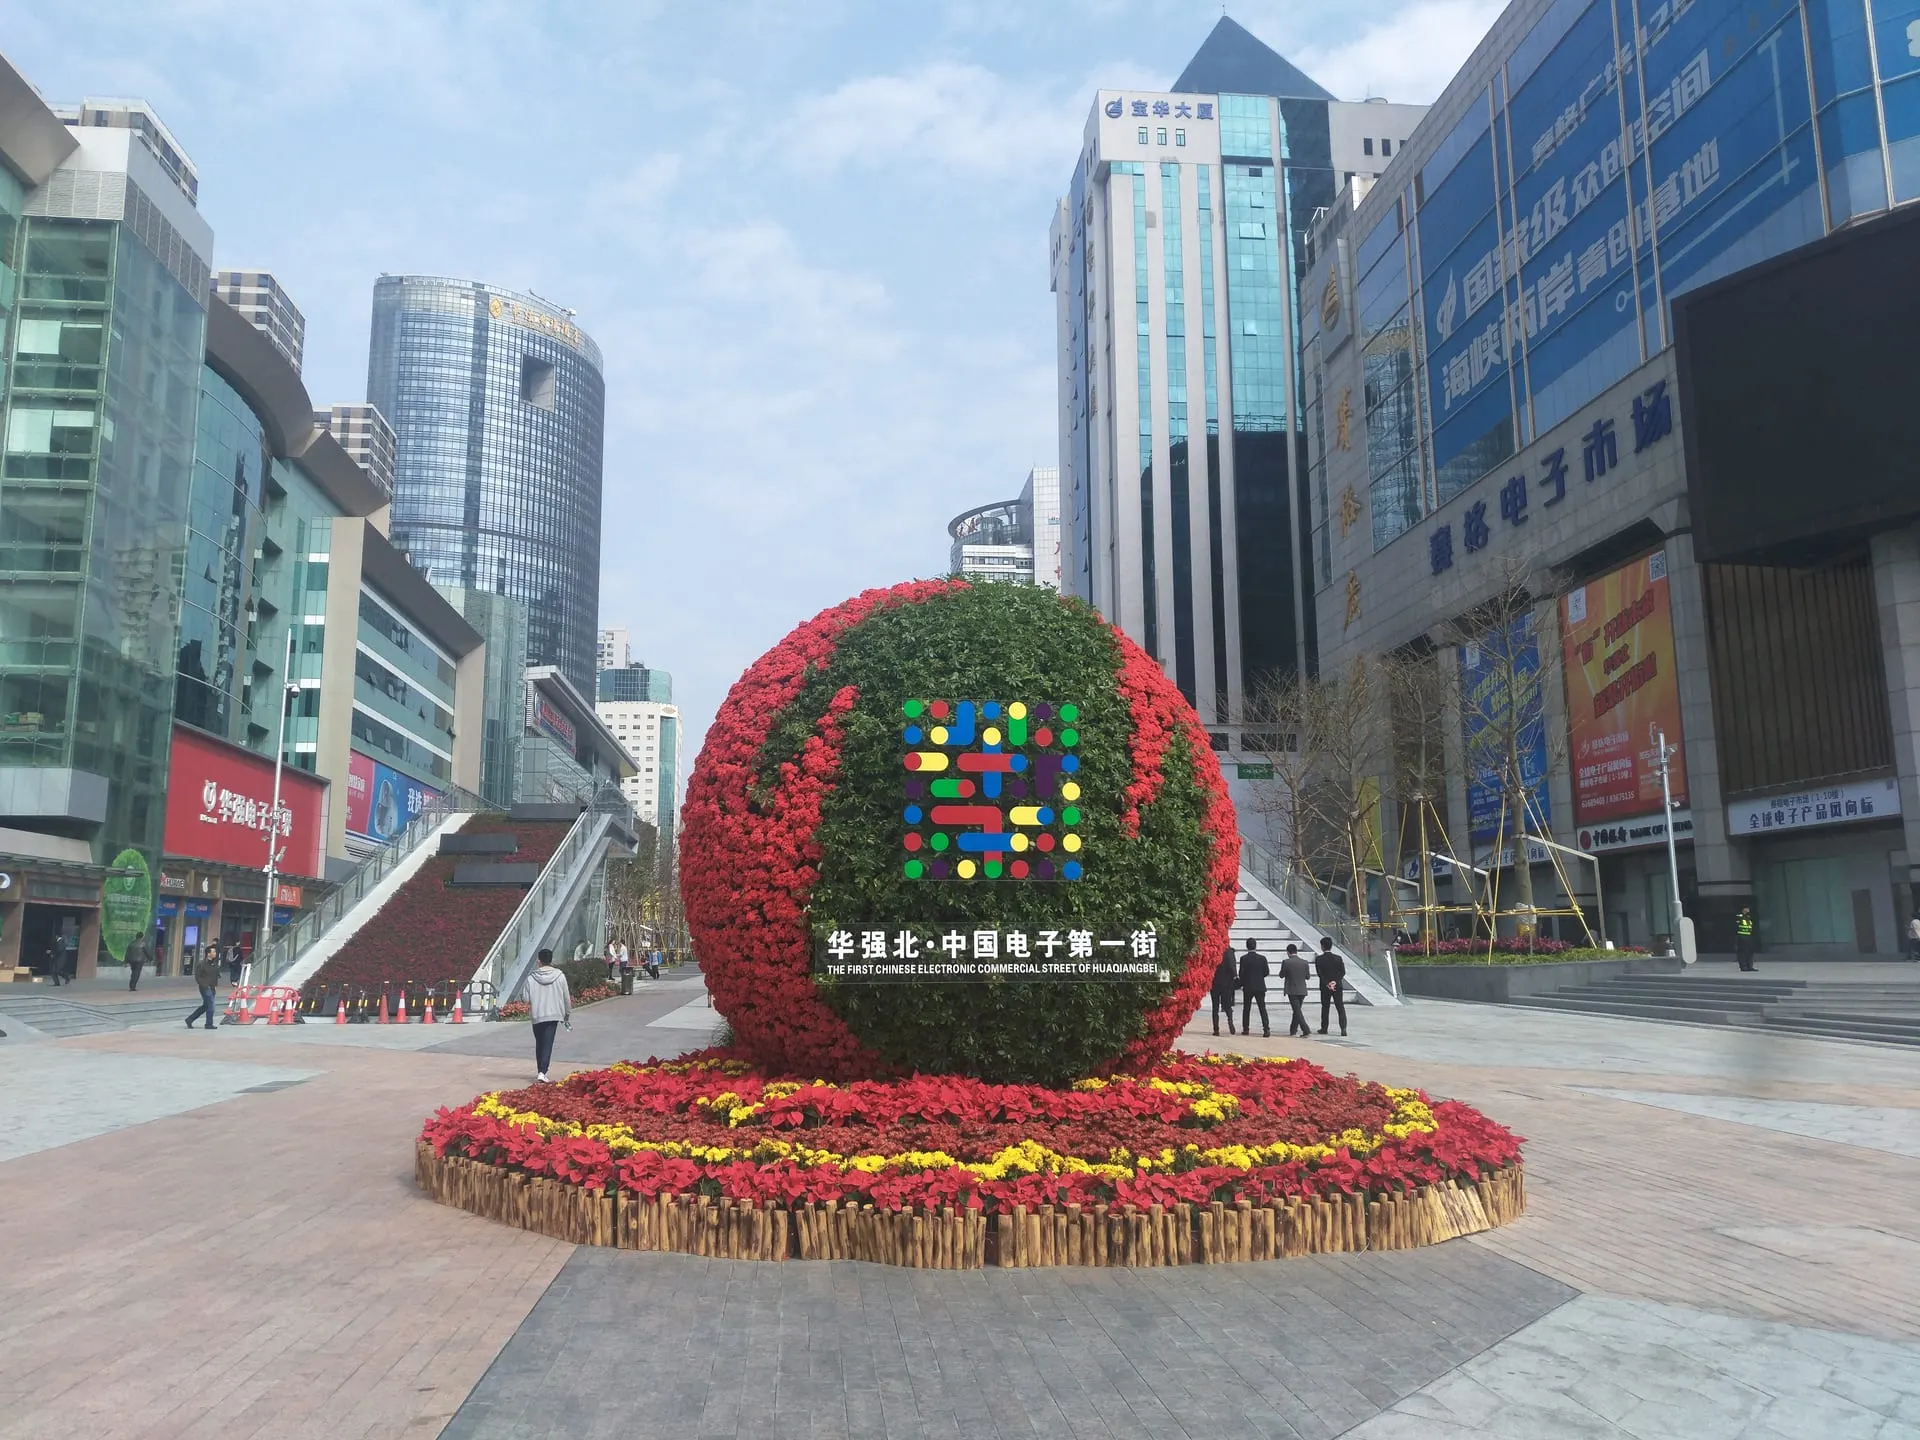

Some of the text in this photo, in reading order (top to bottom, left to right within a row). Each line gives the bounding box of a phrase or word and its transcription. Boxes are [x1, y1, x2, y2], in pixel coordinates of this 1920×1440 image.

[1131, 99, 1214, 120] 宝华大厦
[1442, 136, 1719, 410] 海峡两岸青创基地
[1429, 379, 1672, 576] 赛格电子市场
[1749, 796, 1873, 829] 全球电子产品风向标
[1593, 826, 1627, 846] 中国银行
[827, 929, 1157, 959] 华强北·中国电子第一街
[827, 963, 1158, 975] THE FIRST CHINESE ELECTRONIC COMMERCIAL STREET OF HUAQIANGBEI
